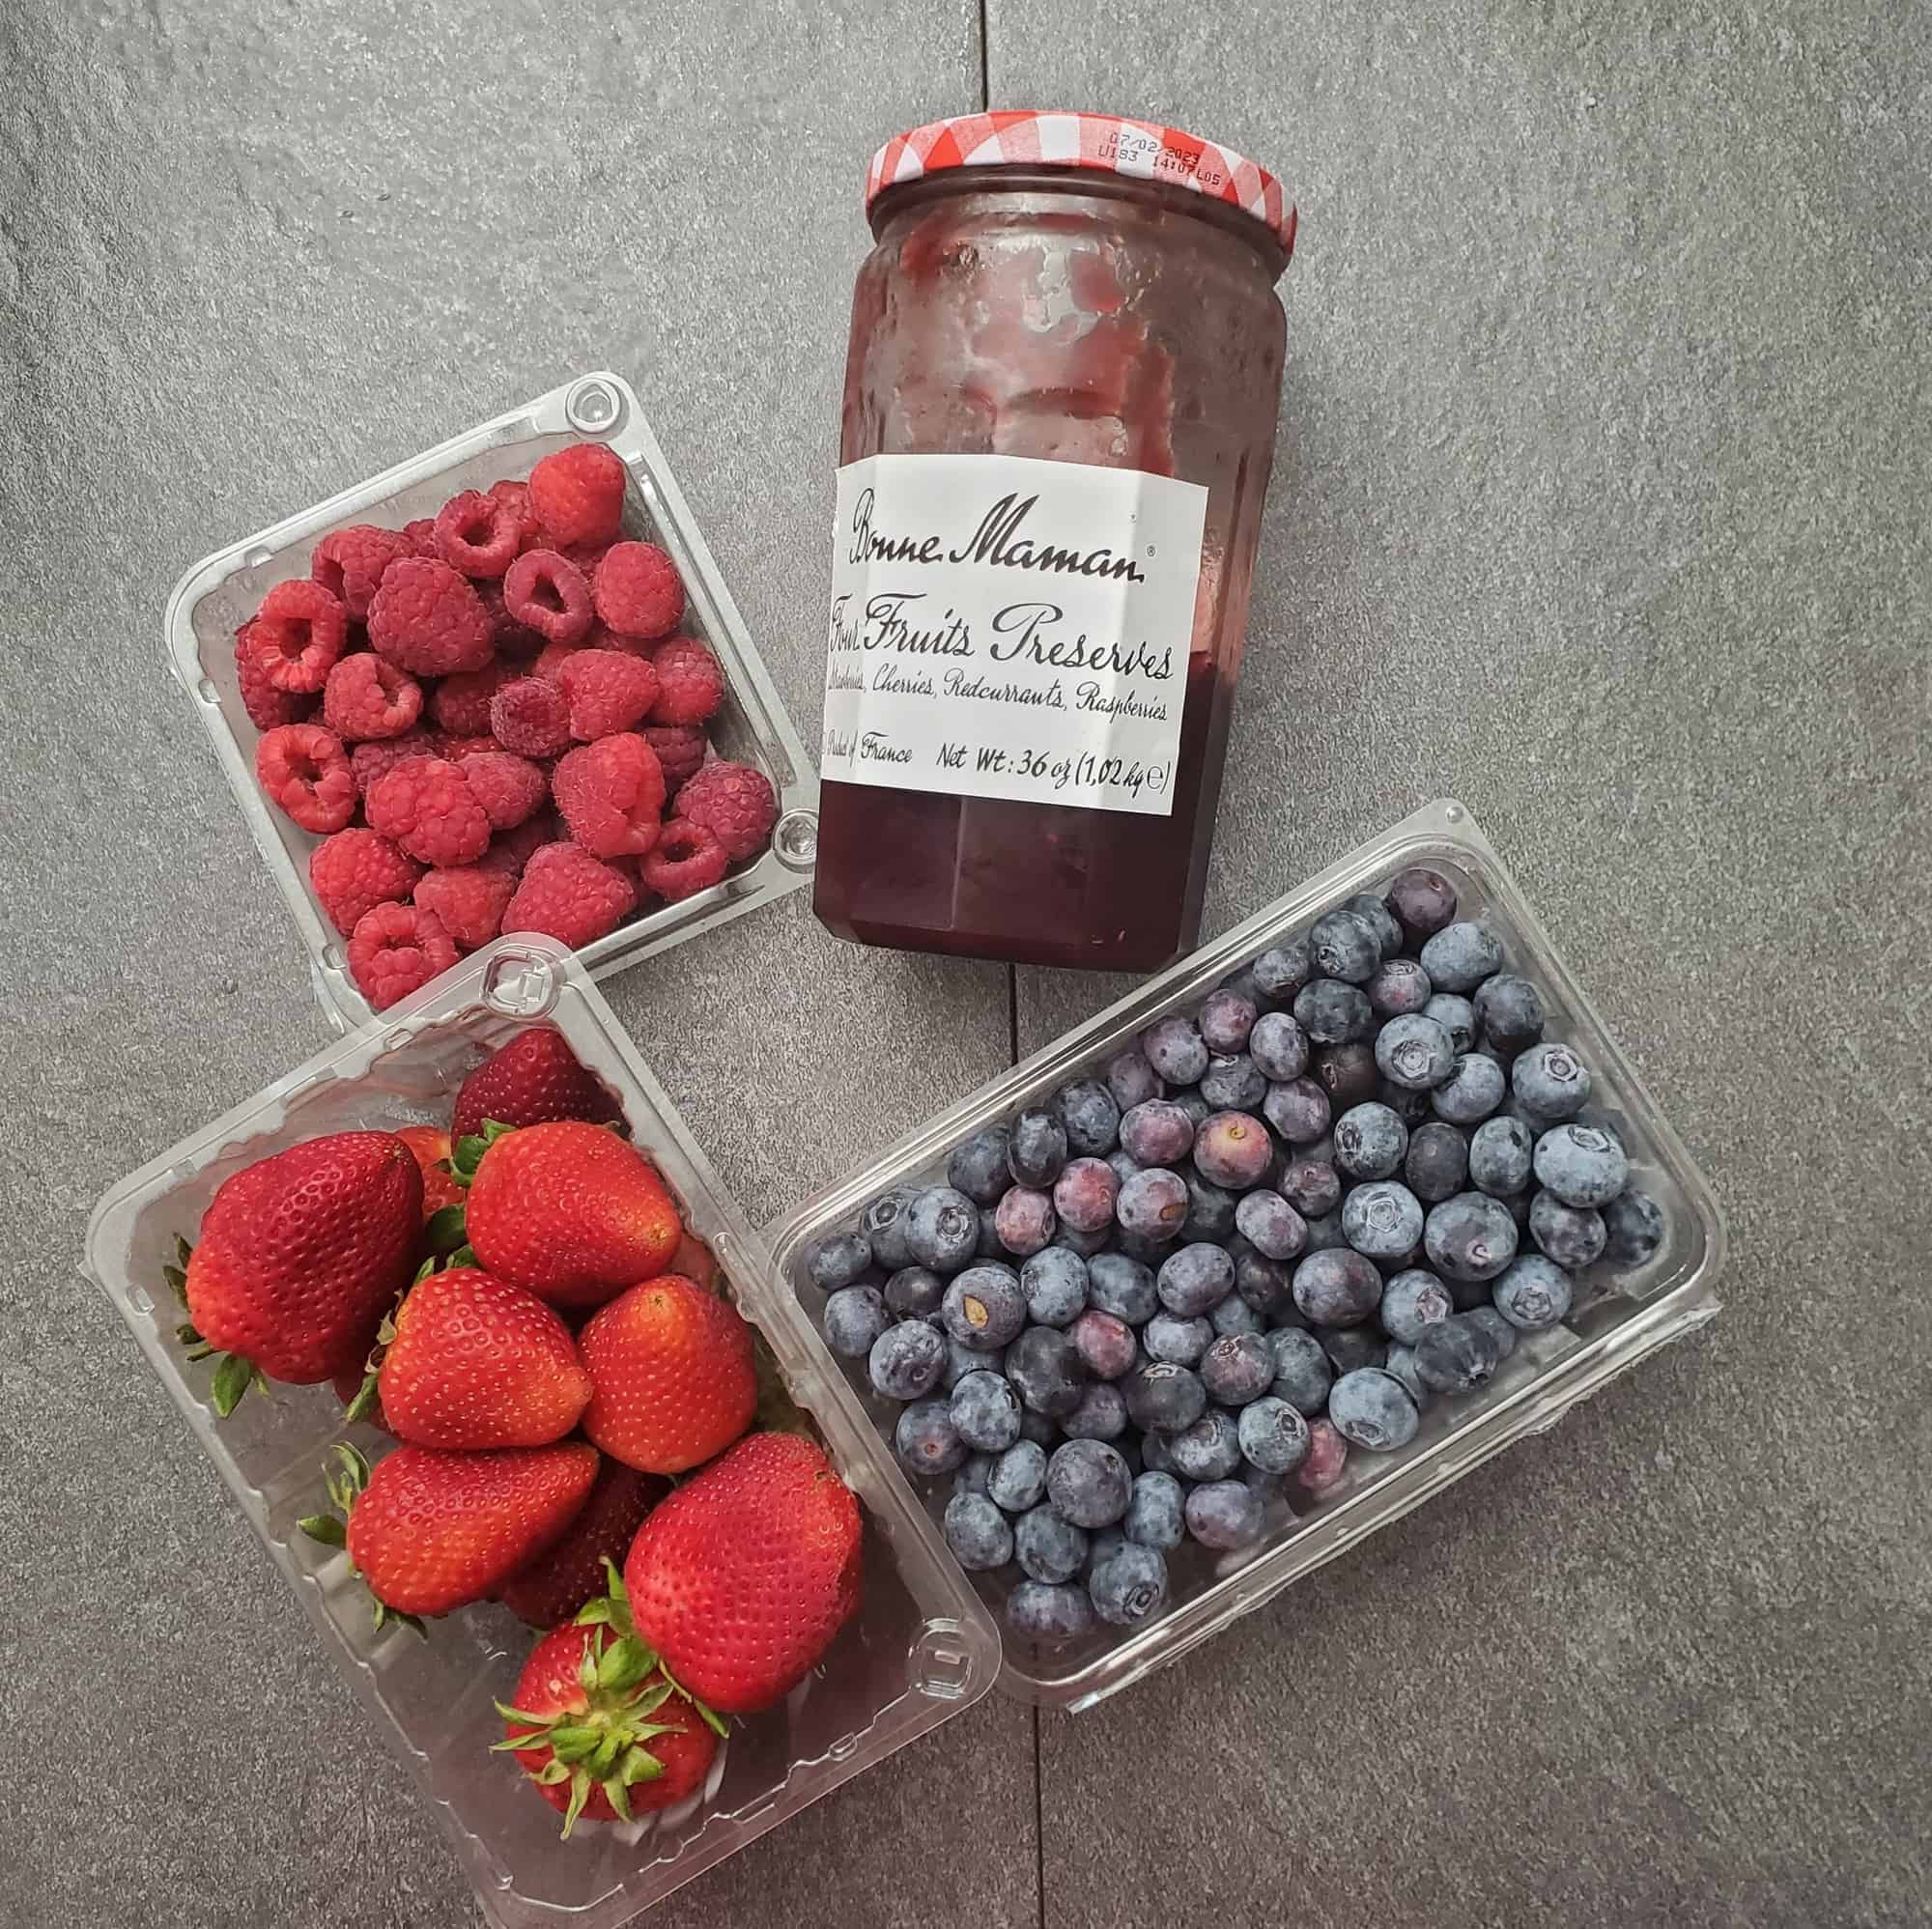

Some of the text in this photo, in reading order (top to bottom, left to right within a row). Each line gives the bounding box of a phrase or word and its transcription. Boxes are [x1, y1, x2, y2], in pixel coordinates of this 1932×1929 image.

[849, 487, 943, 564] Bonne
[831, 592, 1174, 680] Four Fruits Preserves
[872, 663, 937, 698] Cherries,
[944, 667, 1067, 711] Redcurrants,
[1075, 681, 1168, 723] Raspberries
[861, 731, 913, 763] France
[936, 743, 969, 769] Net
[1016, 750, 1050, 778] 36
[1050, 757, 1071, 789] oz
